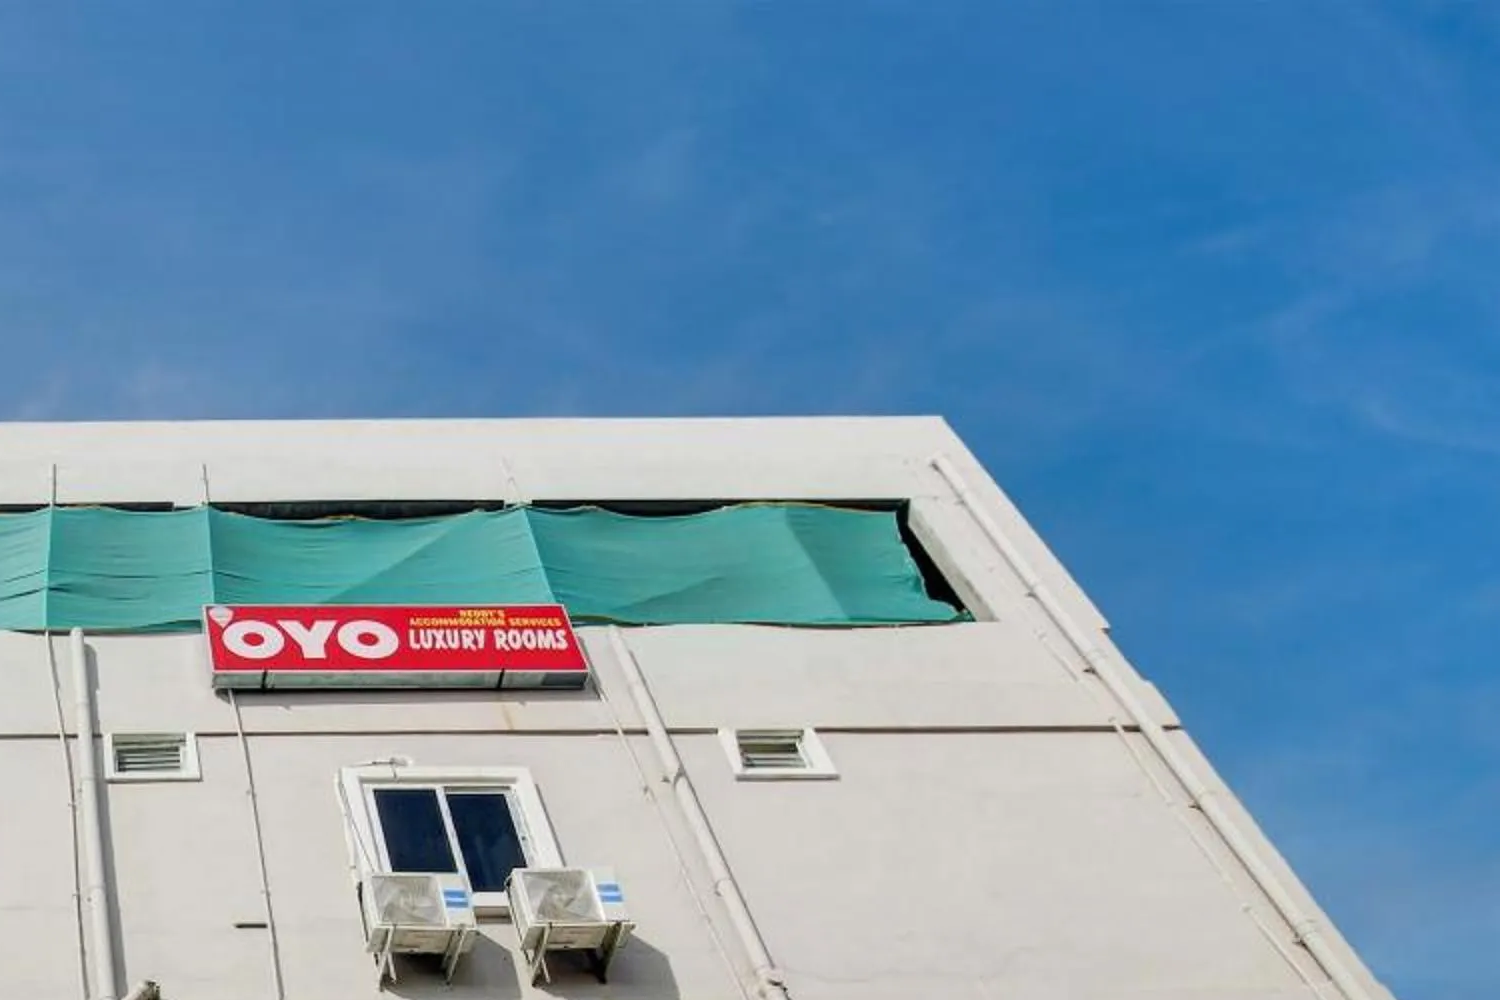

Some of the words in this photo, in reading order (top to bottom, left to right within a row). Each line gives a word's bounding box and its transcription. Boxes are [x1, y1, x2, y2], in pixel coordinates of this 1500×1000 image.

[223, 618, 399, 660] OYO
[409, 628, 486, 651] LUXURY
[493, 627, 569, 651] ROOMS
